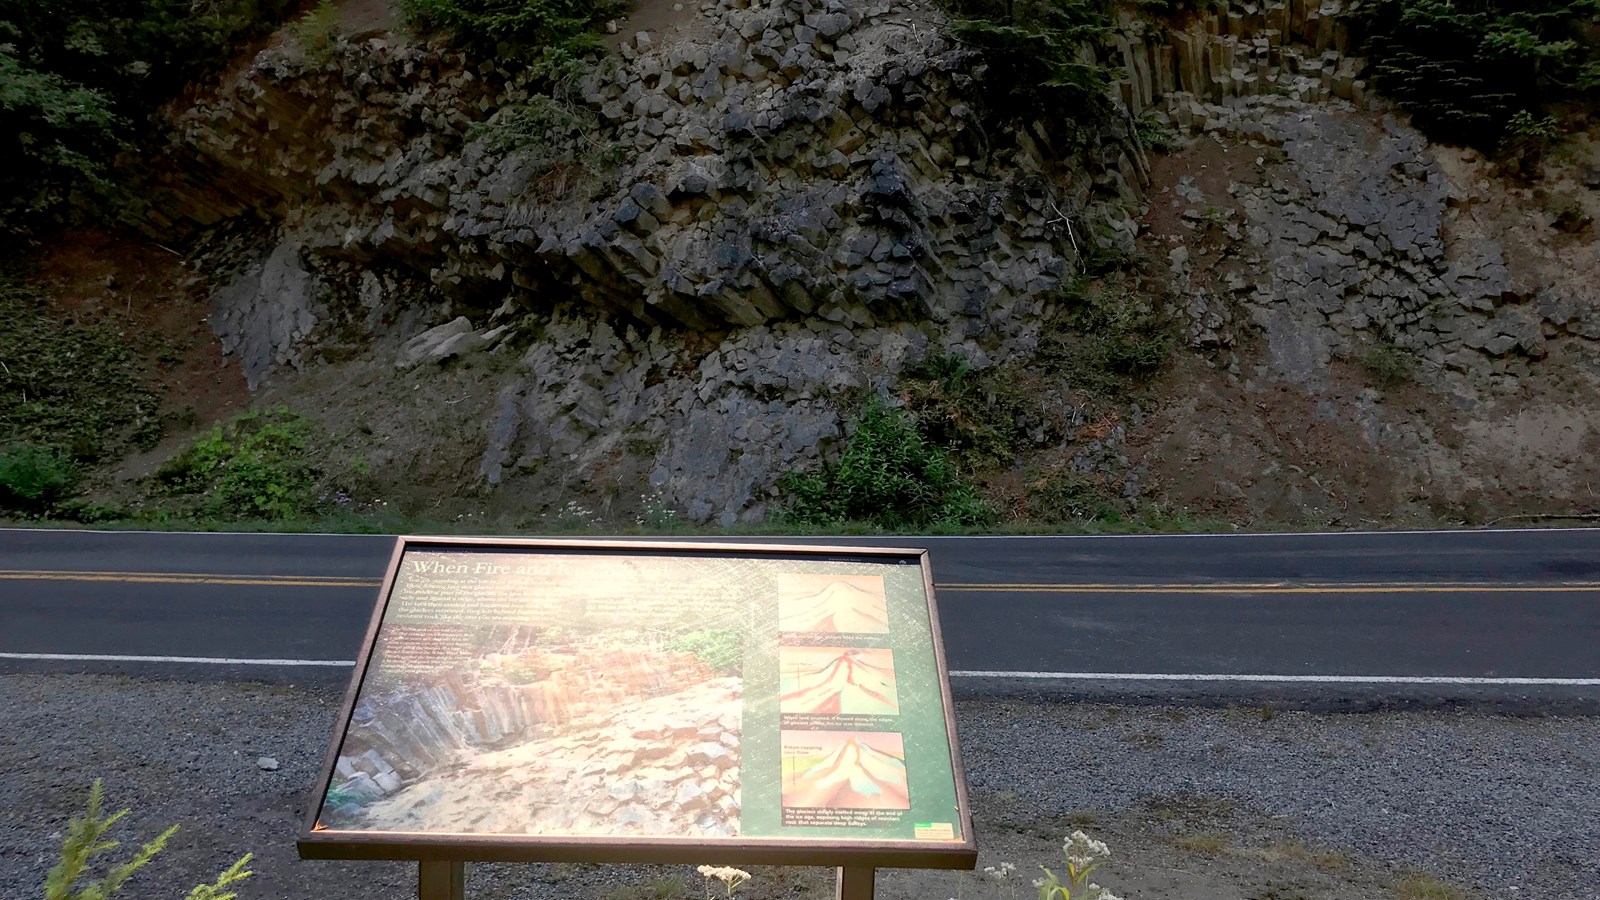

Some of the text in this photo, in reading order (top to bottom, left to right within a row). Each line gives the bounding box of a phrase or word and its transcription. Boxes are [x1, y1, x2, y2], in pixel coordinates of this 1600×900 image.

[412, 560, 468, 574] When
[474, 562, 511, 575] Fire
[515, 563, 551, 576] and
